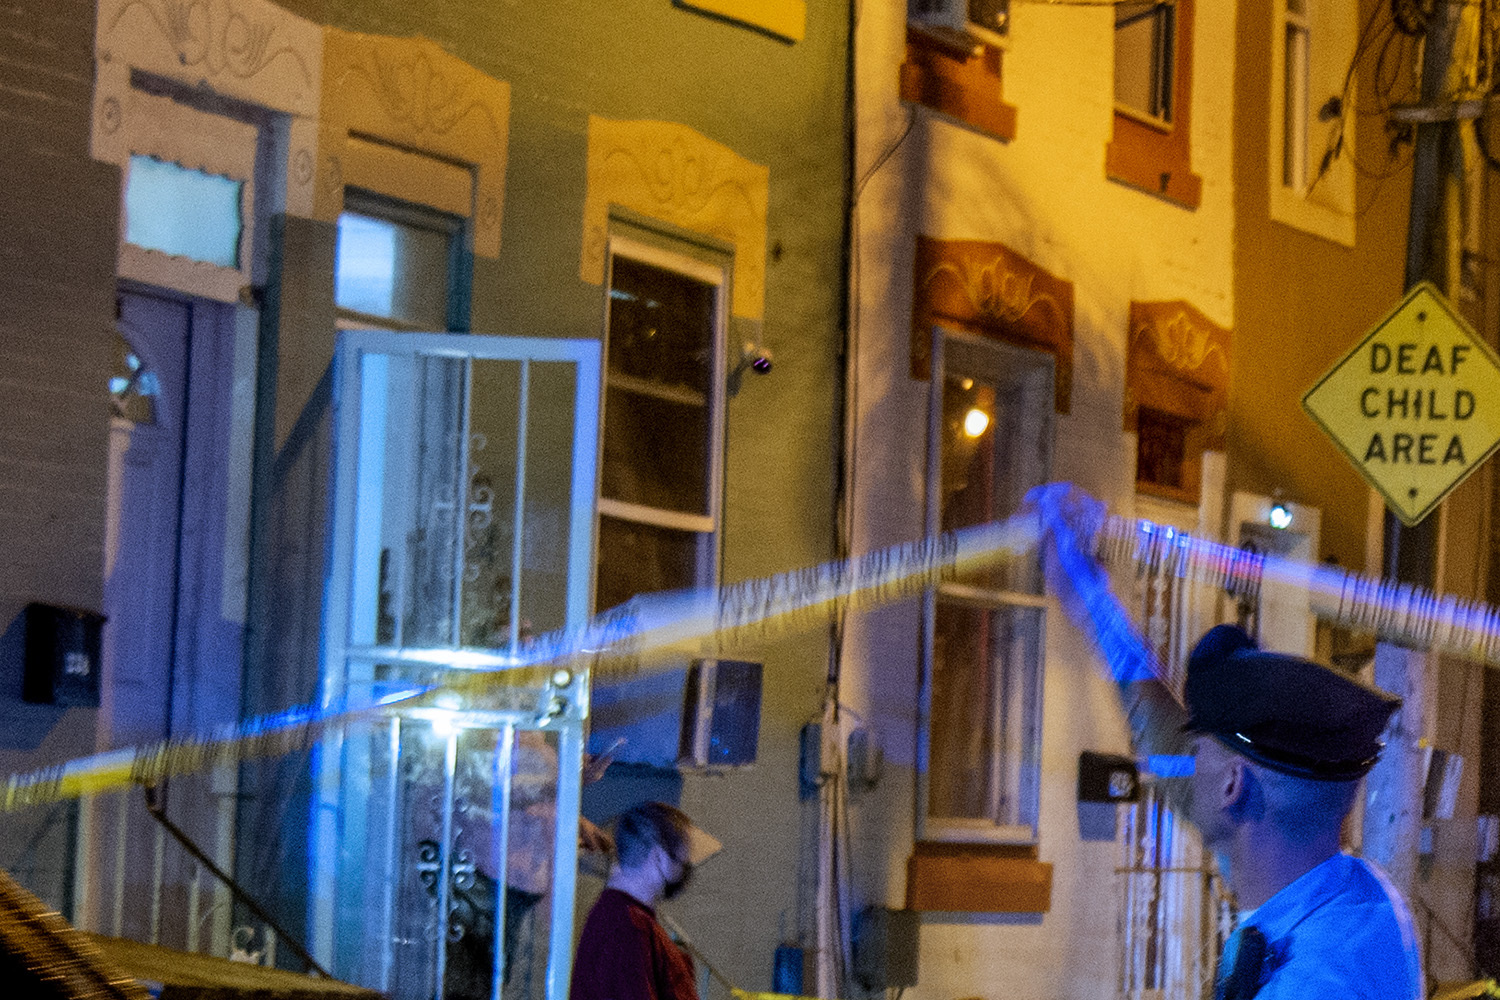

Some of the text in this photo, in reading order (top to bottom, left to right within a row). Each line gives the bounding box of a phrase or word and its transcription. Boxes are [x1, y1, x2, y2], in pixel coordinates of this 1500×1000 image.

[1370, 343, 1470, 375] DEAF
[1360, 387, 1476, 420] CHILD
[1364, 432, 1467, 465] AREA
